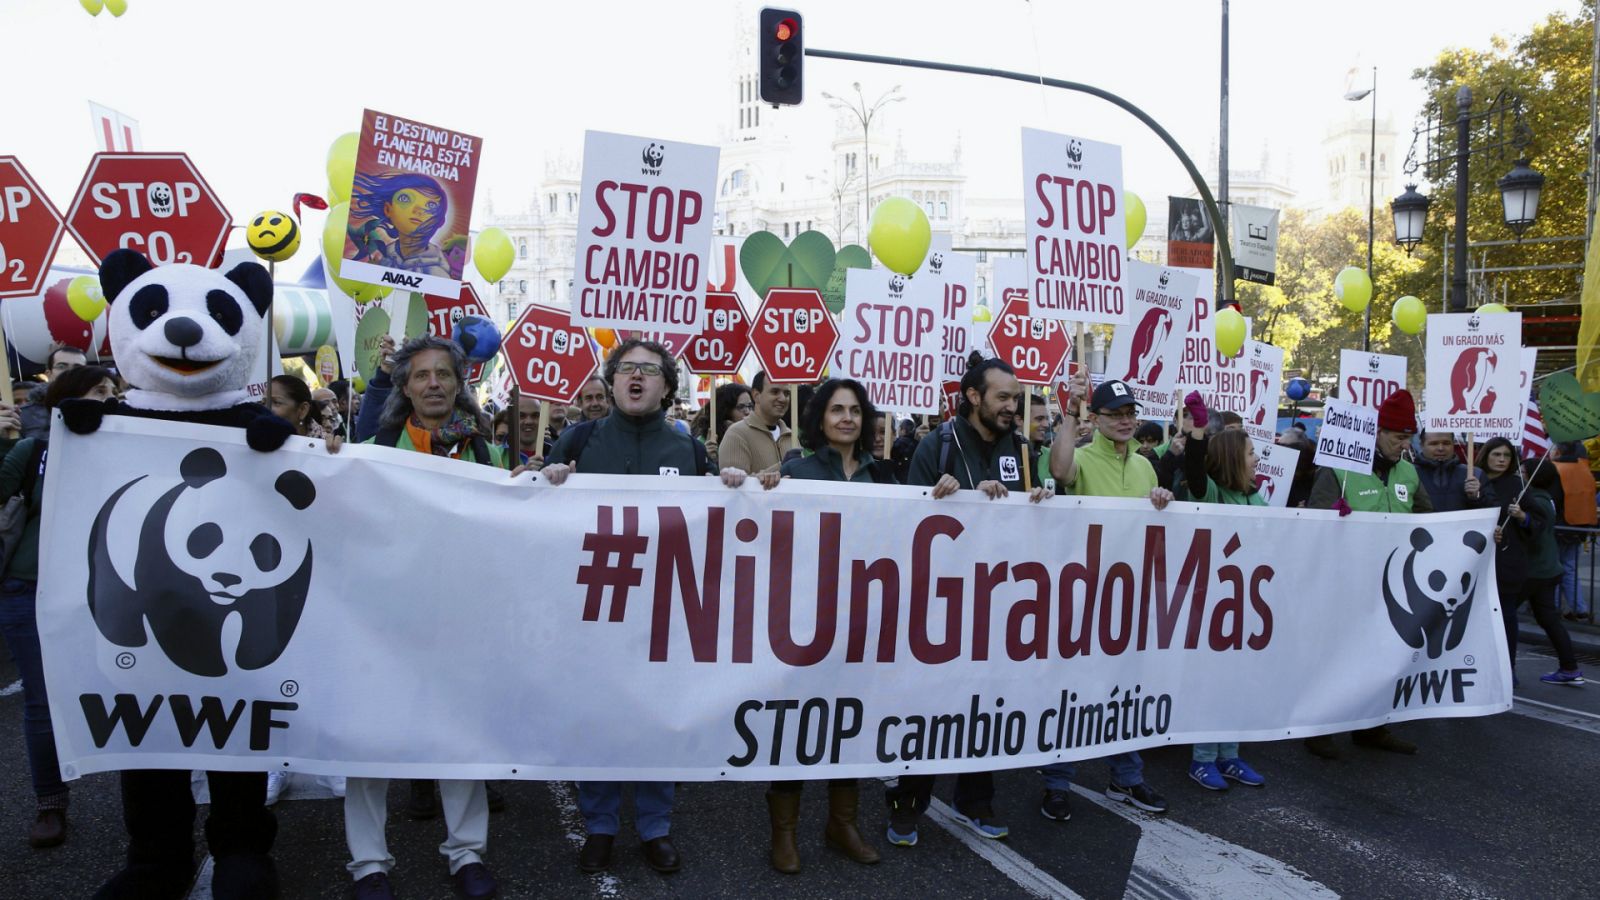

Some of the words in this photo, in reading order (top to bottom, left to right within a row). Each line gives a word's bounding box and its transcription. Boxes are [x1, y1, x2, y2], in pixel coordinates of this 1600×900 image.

[373, 132, 433, 158] PLANETA
[437, 147, 471, 167] ESTÁ
[375, 115, 389, 131] EL
[393, 119, 448, 145] DESTINO
[451, 134, 473, 153] DEL
[378, 150, 396, 168] EN
[398, 154, 459, 182] MARCHA
[641, 167, 663, 177] WWF
[1067, 163, 1083, 171] WWF
[91, 182, 200, 219] STOP
[591, 180, 703, 244] STOP
[1035, 173, 1116, 235] STOP
[585, 245, 699, 292] CAMBIO
[1035, 235, 1121, 282] CAMBIO
[381, 271, 423, 288] AVAAZ
[1035, 278, 1124, 315] CLIMÁTICO
[580, 286, 697, 325] CLIMÁTICO
[1135, 288, 1146, 301] UN
[1146, 290, 1168, 307] GRADO
[1168, 296, 1183, 310] MÁS
[764, 307, 824, 333] STOP
[853, 302, 934, 347] STOP
[1004, 313, 1058, 341] STOP
[520, 322, 585, 356] STOP
[694, 338, 733, 366] CO2
[1180, 337, 1211, 364] BIO
[1442, 335, 1454, 346] UN
[1456, 334, 1483, 346] GRADO
[1485, 333, 1505, 345] MÁS
[775, 342, 815, 373] CO2
[850, 348, 934, 383] CAMBIO
[1012, 345, 1048, 377] CO2
[1176, 363, 1212, 384] ÁTICO
[527, 357, 569, 394] CO2
[1147, 390, 1169, 405] MENOS
[1326, 406, 1352, 429] Cambia
[1353, 412, 1362, 432] tu
[1362, 417, 1376, 440] vida,
[1431, 418, 1448, 428] UNA
[1450, 417, 1481, 429] ESPECIE
[1484, 417, 1513, 429] MENOS
[1319, 438, 1334, 452] no
[1337, 438, 1346, 455] tu
[1347, 440, 1372, 462] clima.
[1270, 464, 1284, 477] MÁS
[576, 505, 1275, 667] #NiUnGradoMás
[1393, 668, 1477, 709] WWF
[79, 693, 299, 751] WWF
[726, 697, 864, 767] STOP
[876, 694, 1027, 764] cambio
[1037, 684, 1173, 753] climático
